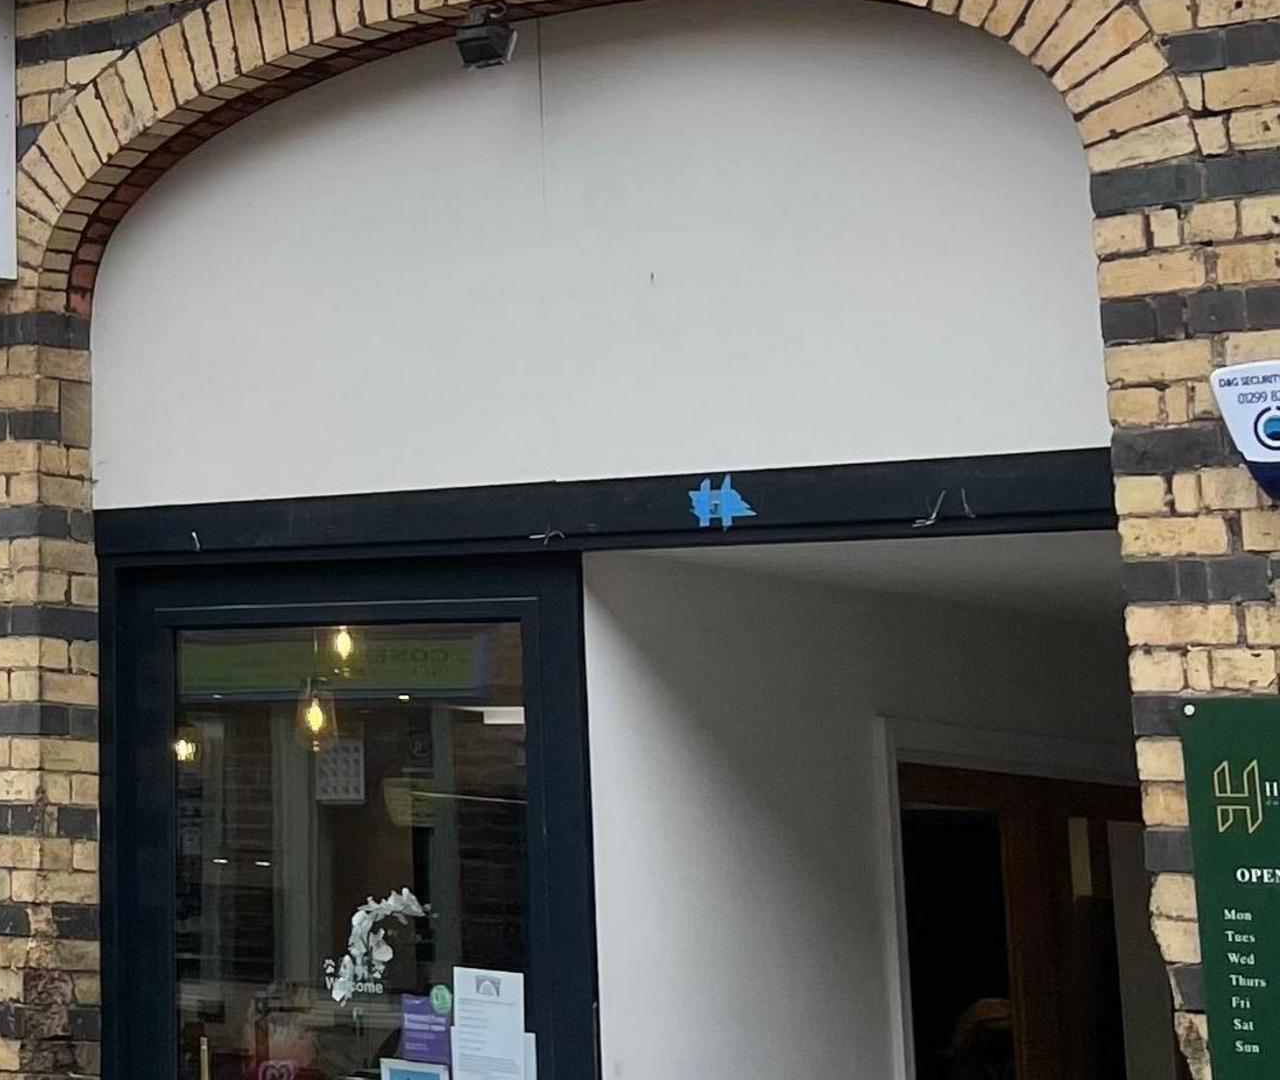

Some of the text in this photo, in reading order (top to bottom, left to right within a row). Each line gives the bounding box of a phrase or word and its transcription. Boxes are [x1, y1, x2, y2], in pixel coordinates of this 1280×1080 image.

[1240, 374, 1280, 386] SECURIT
[1224, 909, 1252, 921] Mon
[1225, 931, 1256, 943] Tues
[1228, 953, 1255, 966] Wed
[1229, 975, 1266, 988] Thurs
[1231, 997, 1251, 1010] Fri
[1233, 1019, 1254, 1032] Sat
[1235, 1041, 1260, 1054] Sun
